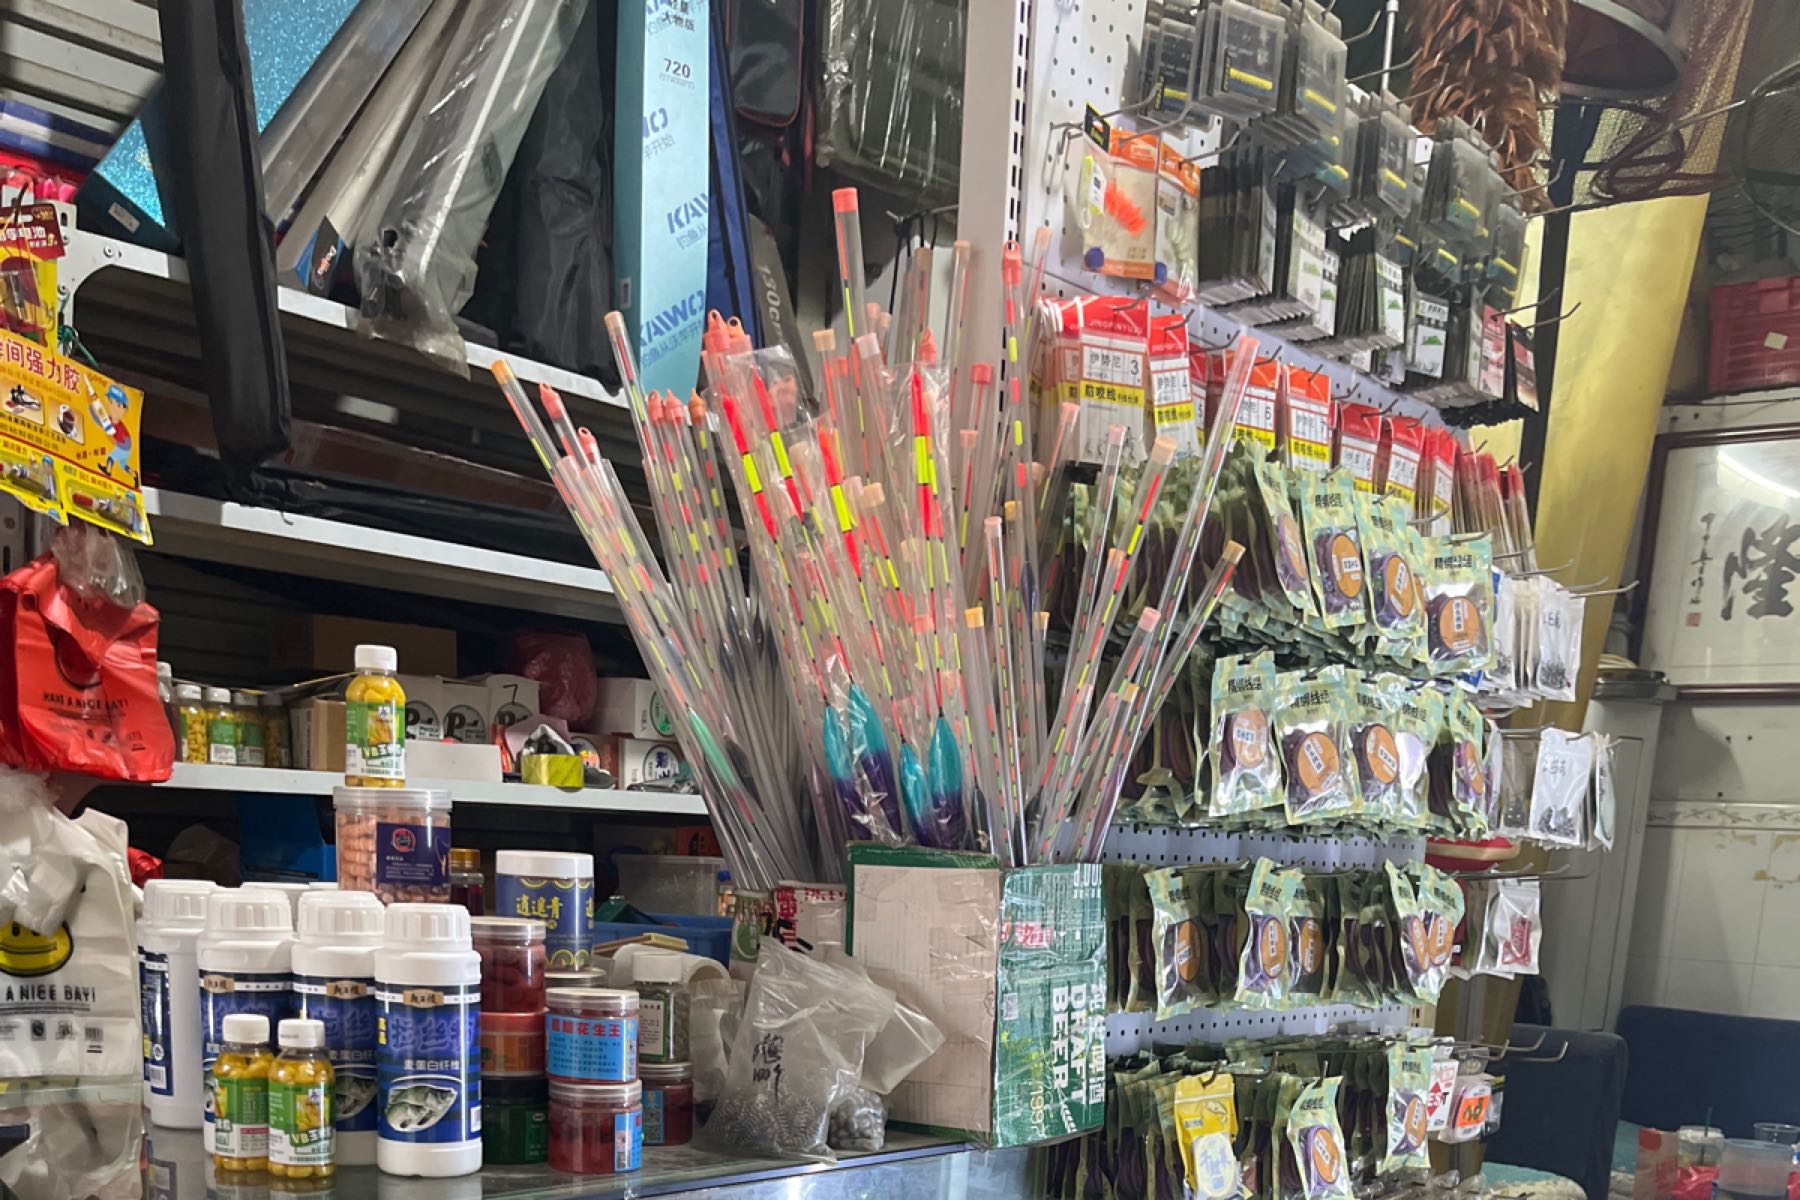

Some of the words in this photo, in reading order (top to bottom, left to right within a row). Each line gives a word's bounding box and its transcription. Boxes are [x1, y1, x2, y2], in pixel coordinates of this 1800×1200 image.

[664, 57, 691, 79] 720
[0, 339, 80, 394] 间强力胶
[1130, 359, 1140, 376] 3
[6, 986, 14, 1001] A
[20, 984, 57, 1001] NICE
[64, 985, 96, 1002] DAY!
[1053, 986, 1069, 1089] BEER
[1071, 984, 1087, 1105] DRAFT
